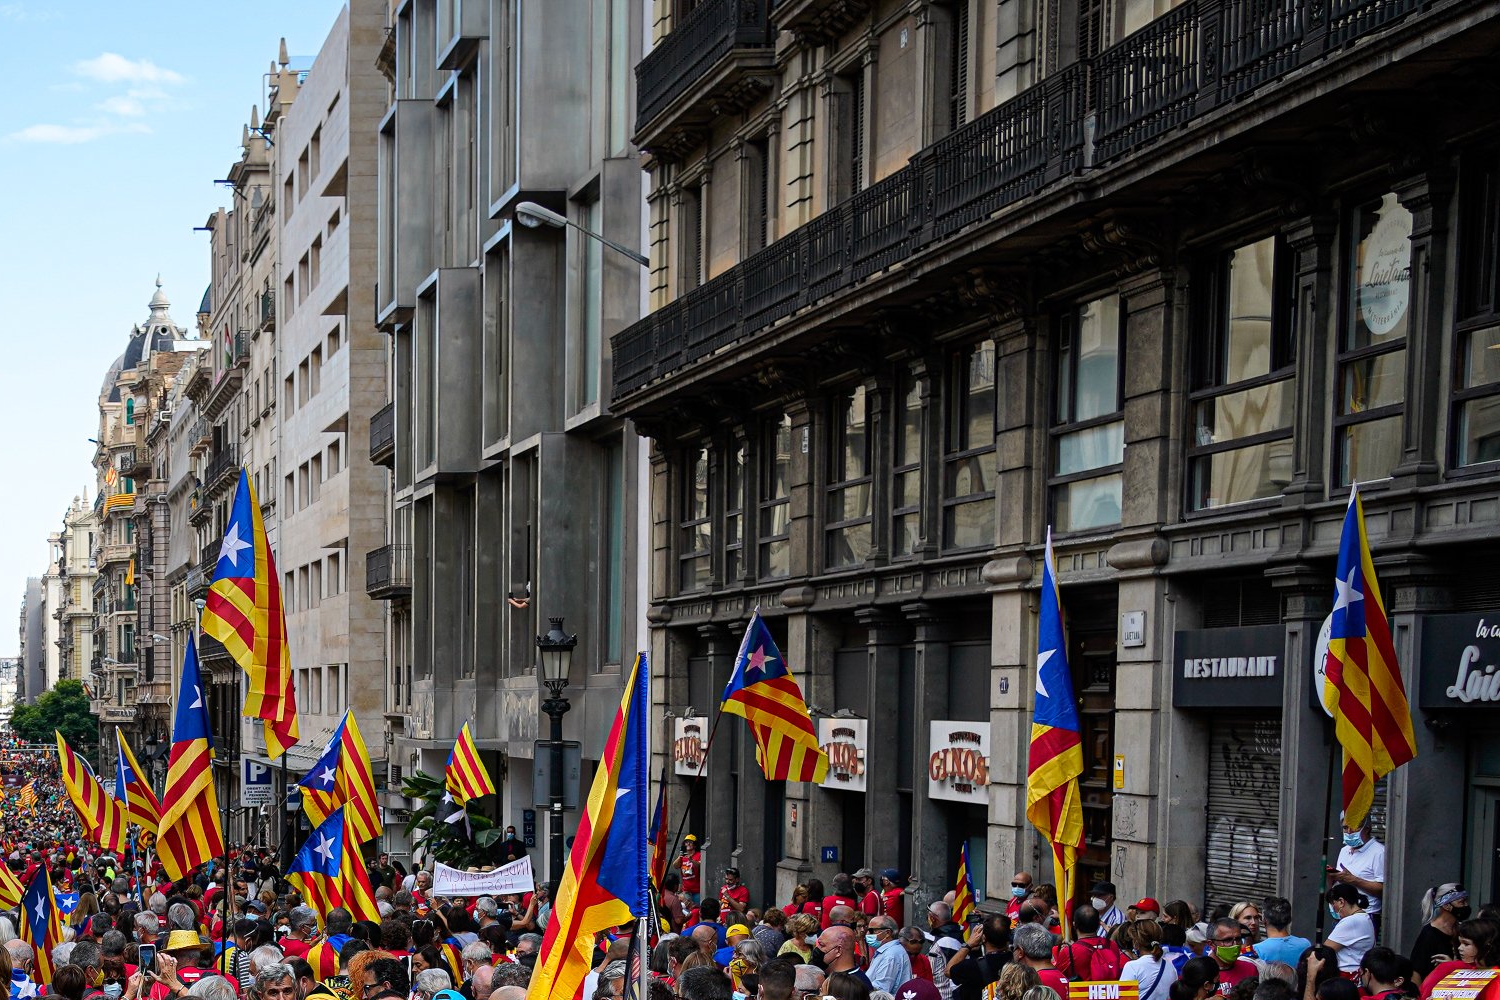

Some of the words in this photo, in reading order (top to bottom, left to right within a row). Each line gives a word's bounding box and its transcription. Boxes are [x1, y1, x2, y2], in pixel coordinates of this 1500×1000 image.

[1184, 656, 1277, 678] RESTAURANT
[250, 761, 267, 782] P
[929, 747, 987, 786] GINOS
[524, 837, 534, 845] 10
[826, 850, 834, 859] R
[1088, 984, 1120, 1000] HEM
